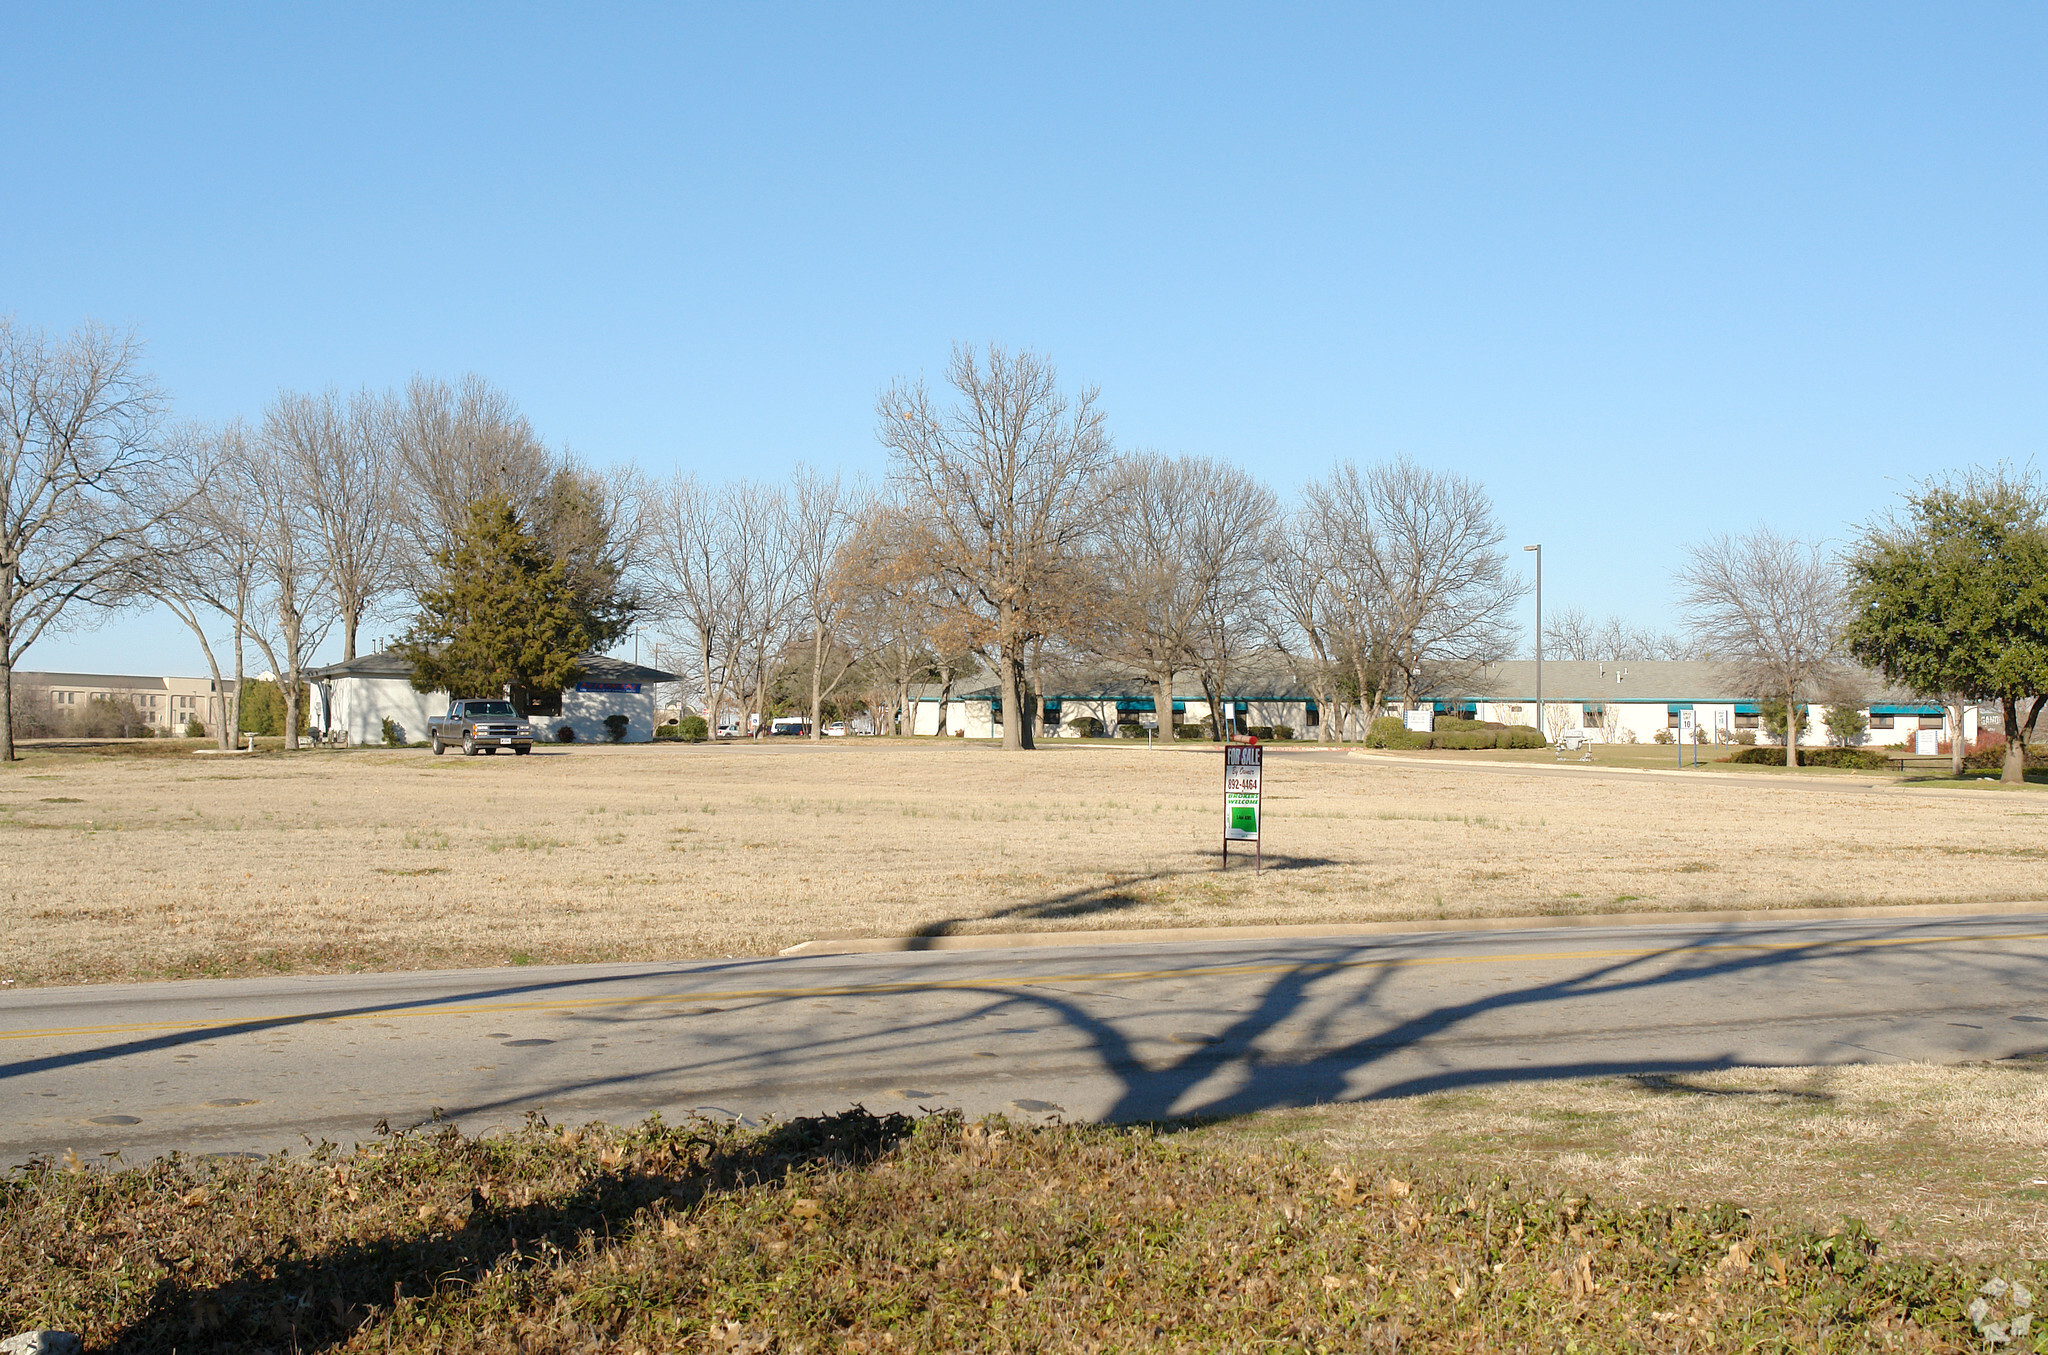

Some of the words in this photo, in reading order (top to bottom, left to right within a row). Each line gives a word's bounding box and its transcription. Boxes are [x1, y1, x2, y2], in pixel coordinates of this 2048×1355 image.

[1228, 748, 1240, 765] FOR
[1241, 748, 1260, 765] SALE
[1232, 766, 1238, 776] By
[1239, 766, 1254, 775] Owner
[1228, 778, 1257, 790] 892-4464
